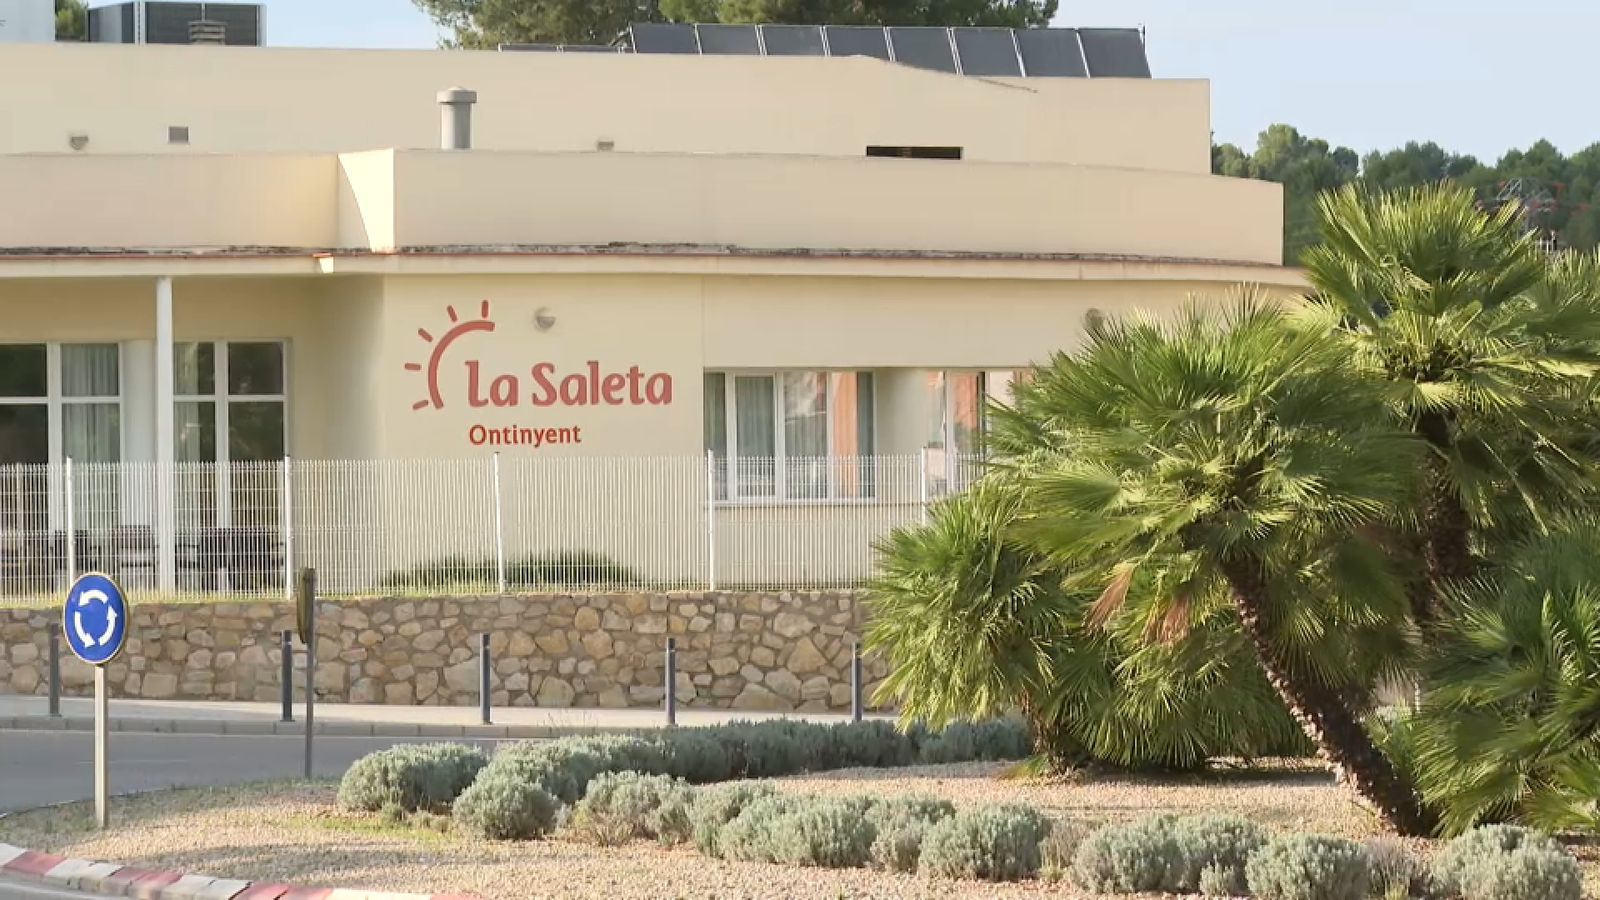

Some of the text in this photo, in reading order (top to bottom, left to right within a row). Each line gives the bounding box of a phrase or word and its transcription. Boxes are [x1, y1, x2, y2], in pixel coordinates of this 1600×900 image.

[465, 360, 673, 408] La Saleta
[469, 424, 582, 448] Ontinyent
